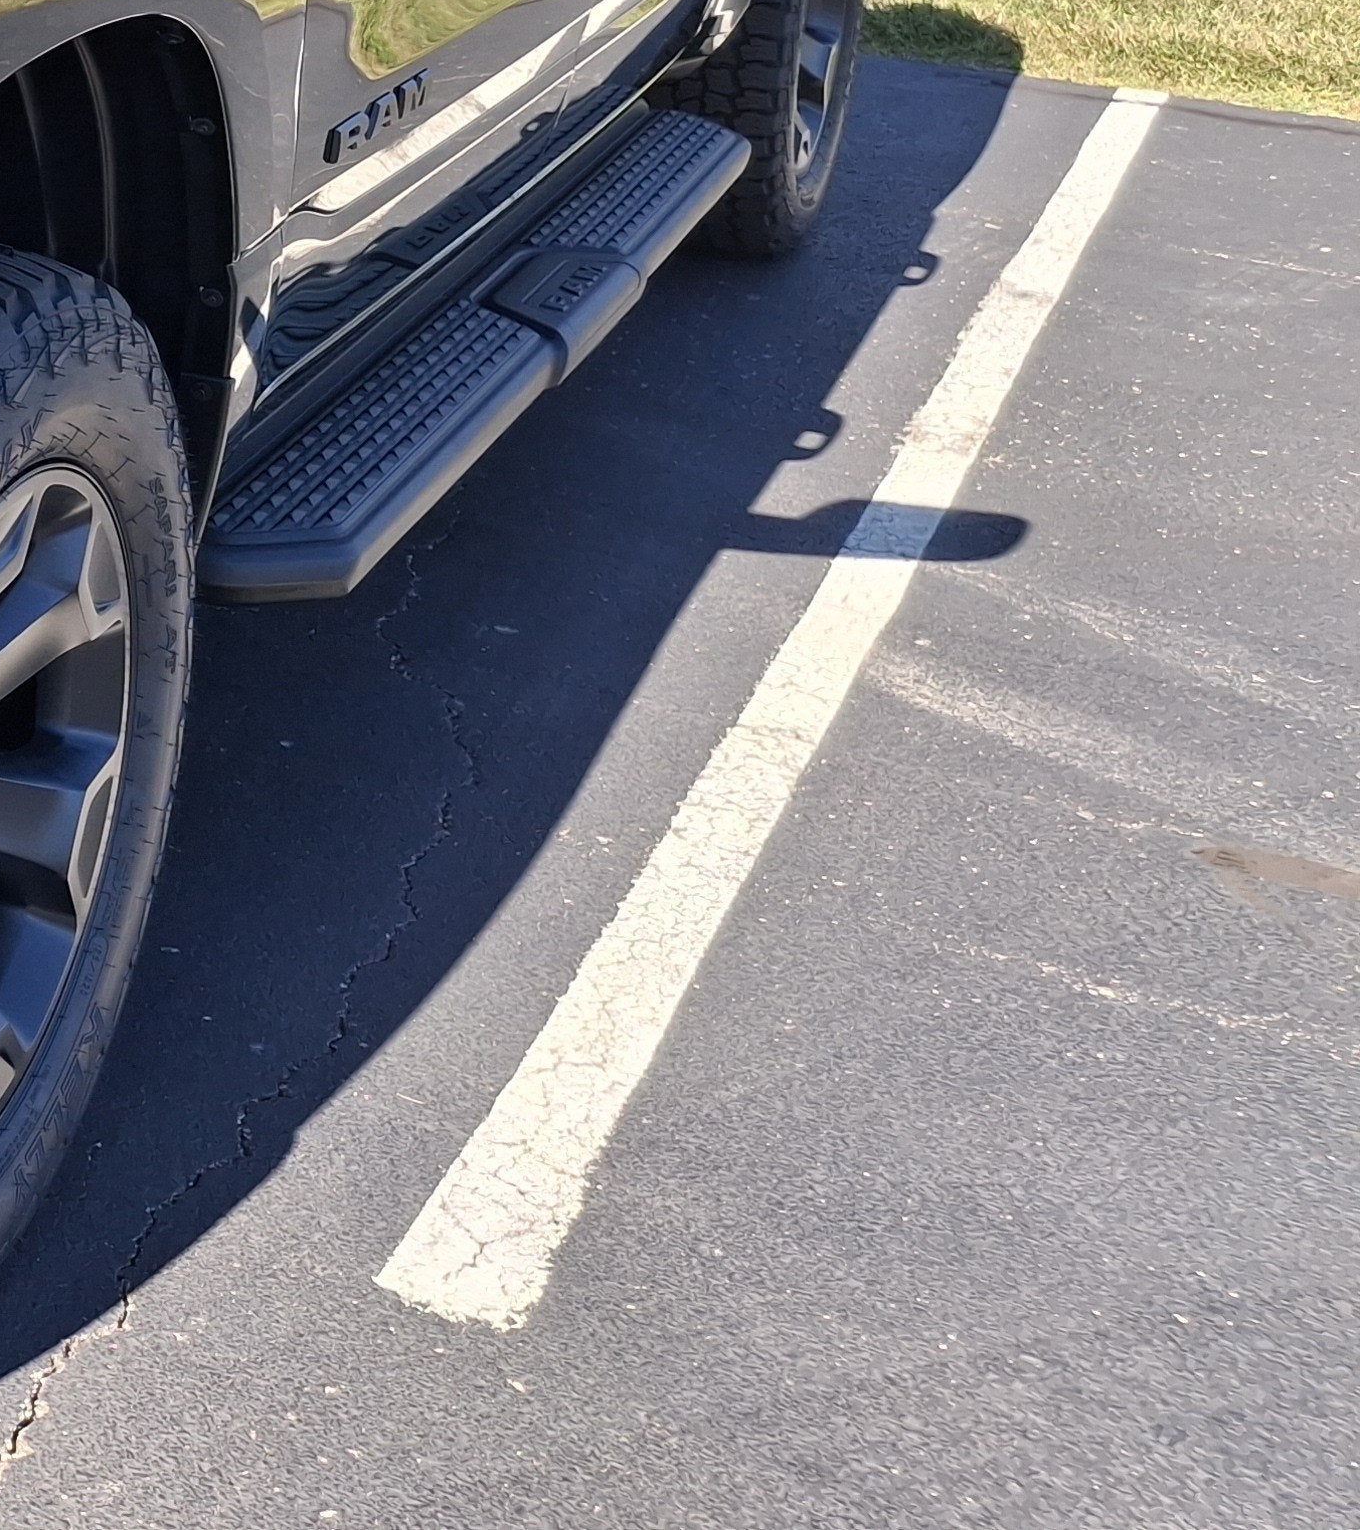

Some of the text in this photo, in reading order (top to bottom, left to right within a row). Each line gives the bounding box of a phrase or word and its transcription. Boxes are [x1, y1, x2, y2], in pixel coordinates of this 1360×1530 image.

[323, 68, 433, 164] RAM
[538, 265, 608, 313] RAM
[13, 1002, 106, 1207] KELLY
